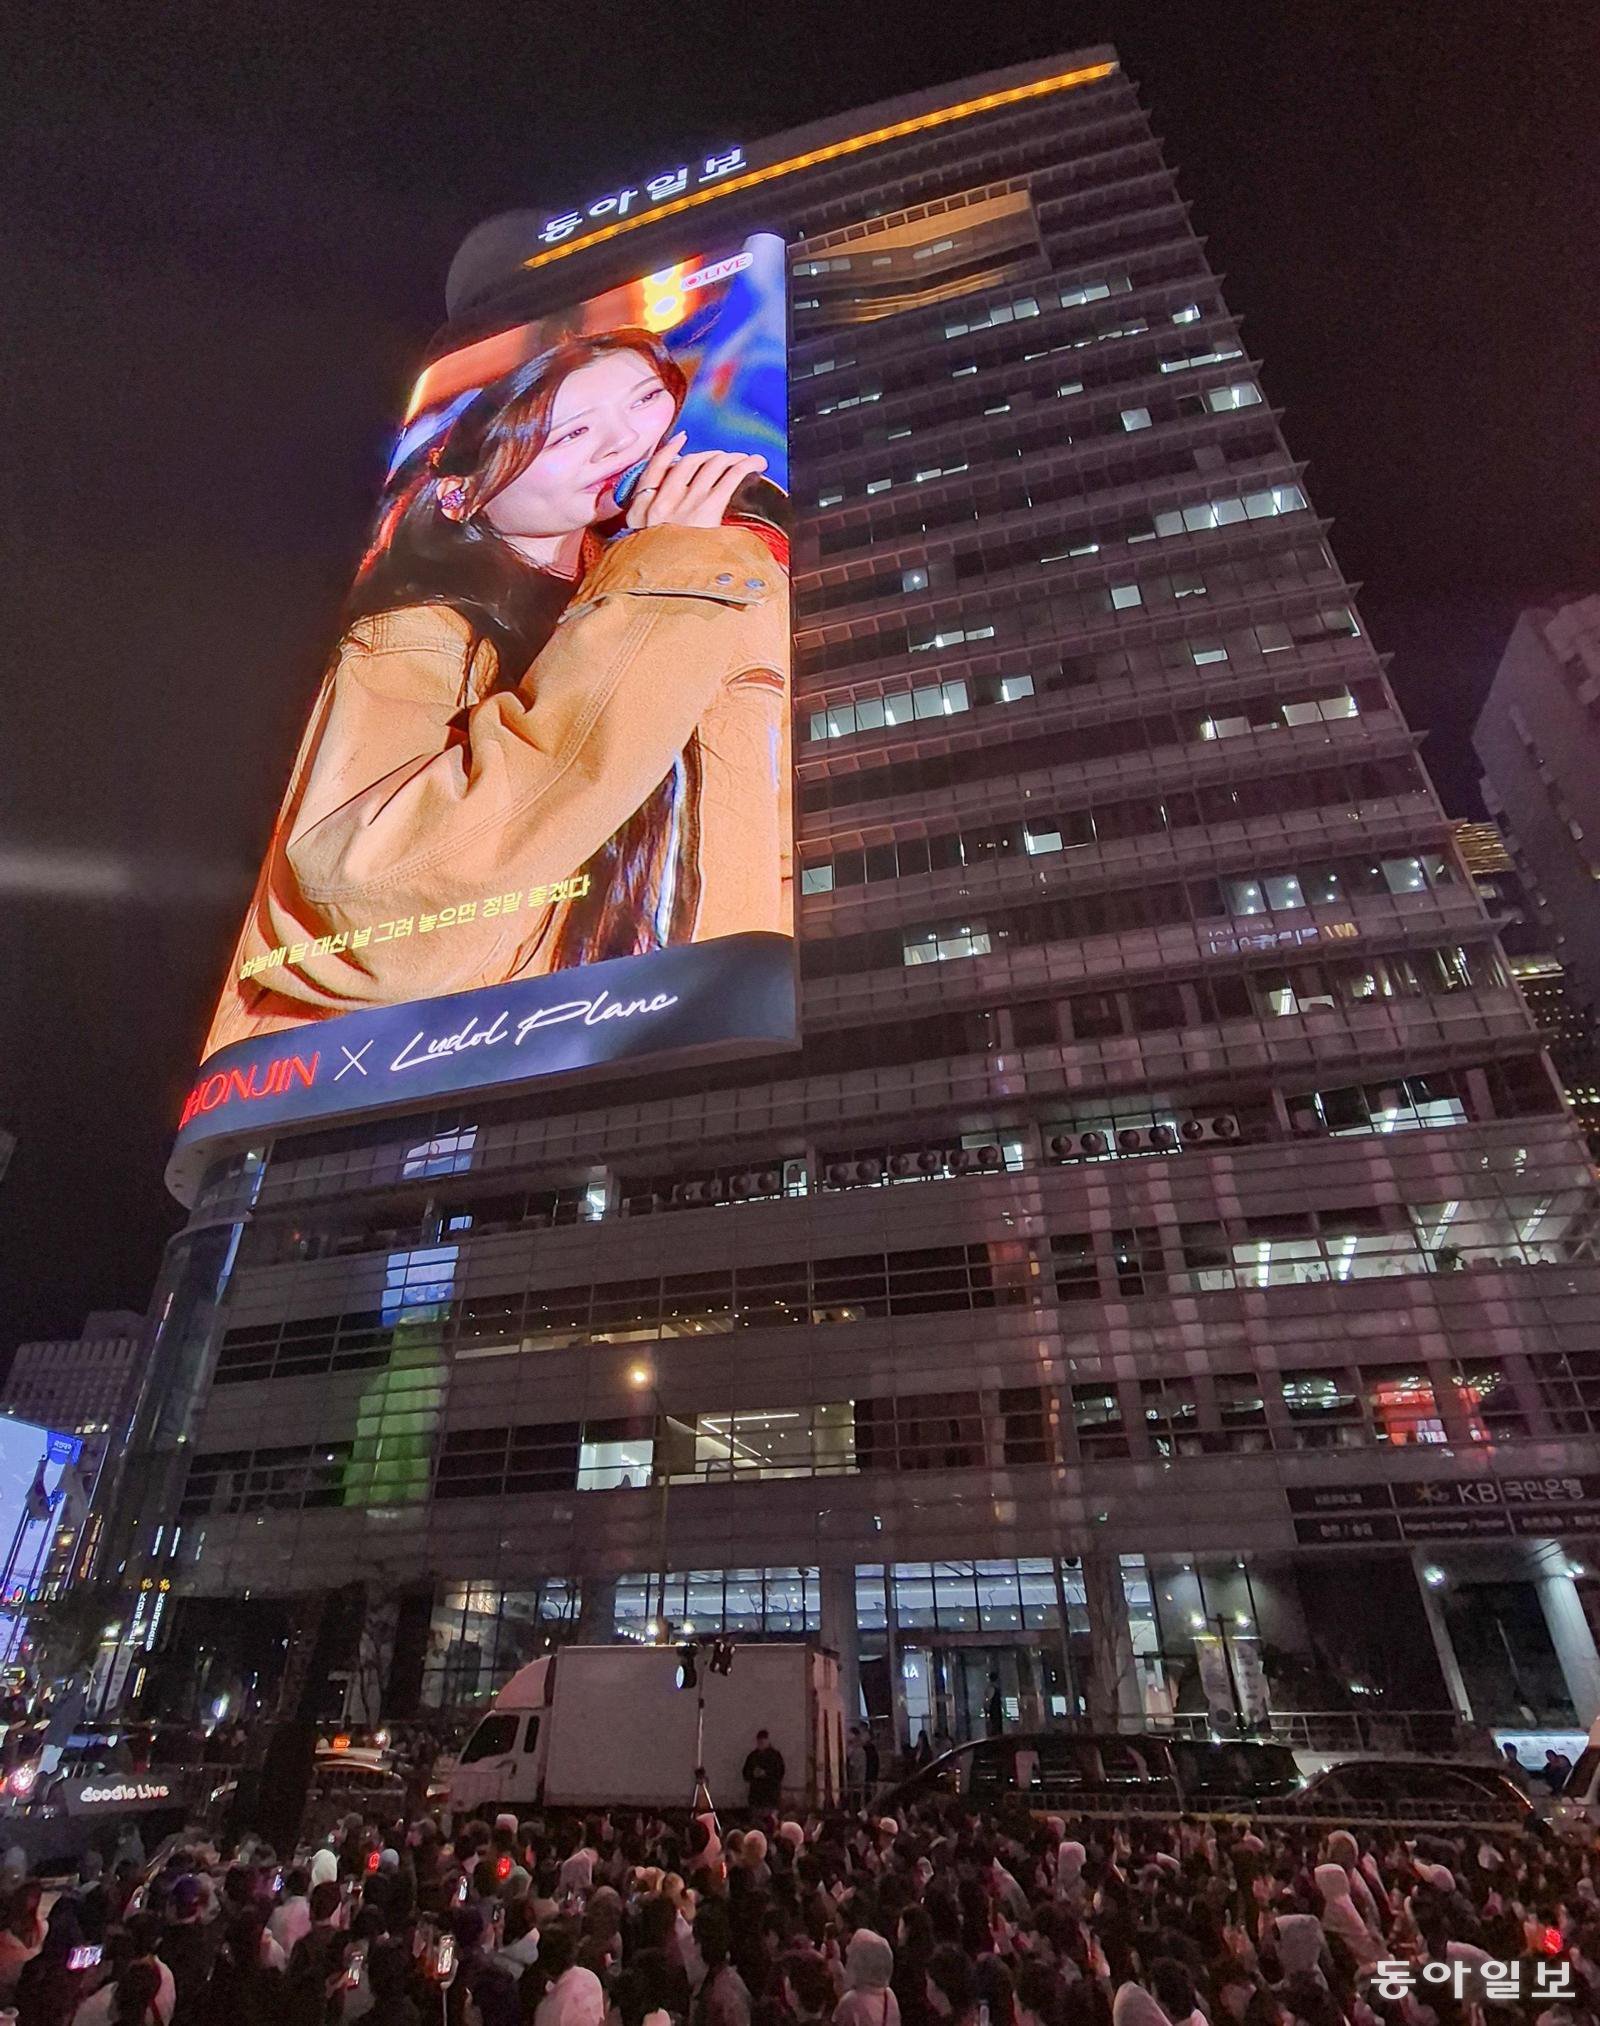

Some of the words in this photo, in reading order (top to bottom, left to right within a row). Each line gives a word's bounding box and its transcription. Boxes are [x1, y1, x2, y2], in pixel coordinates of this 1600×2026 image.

[538, 147, 746, 243] 동아일보
[704, 256, 748, 281] LIVE
[239, 946, 288, 980] 하늘에
[287, 942, 310, 964] 달
[311, 931, 349, 957] 대신
[351, 926, 372, 949] 널
[374, 916, 414, 943] 그려
[418, 902, 477, 933] 놓으면
[482, 890, 523, 918] 정말
[527, 874, 591, 908] 좋겠다
[1457, 1482, 1498, 1504] KB
